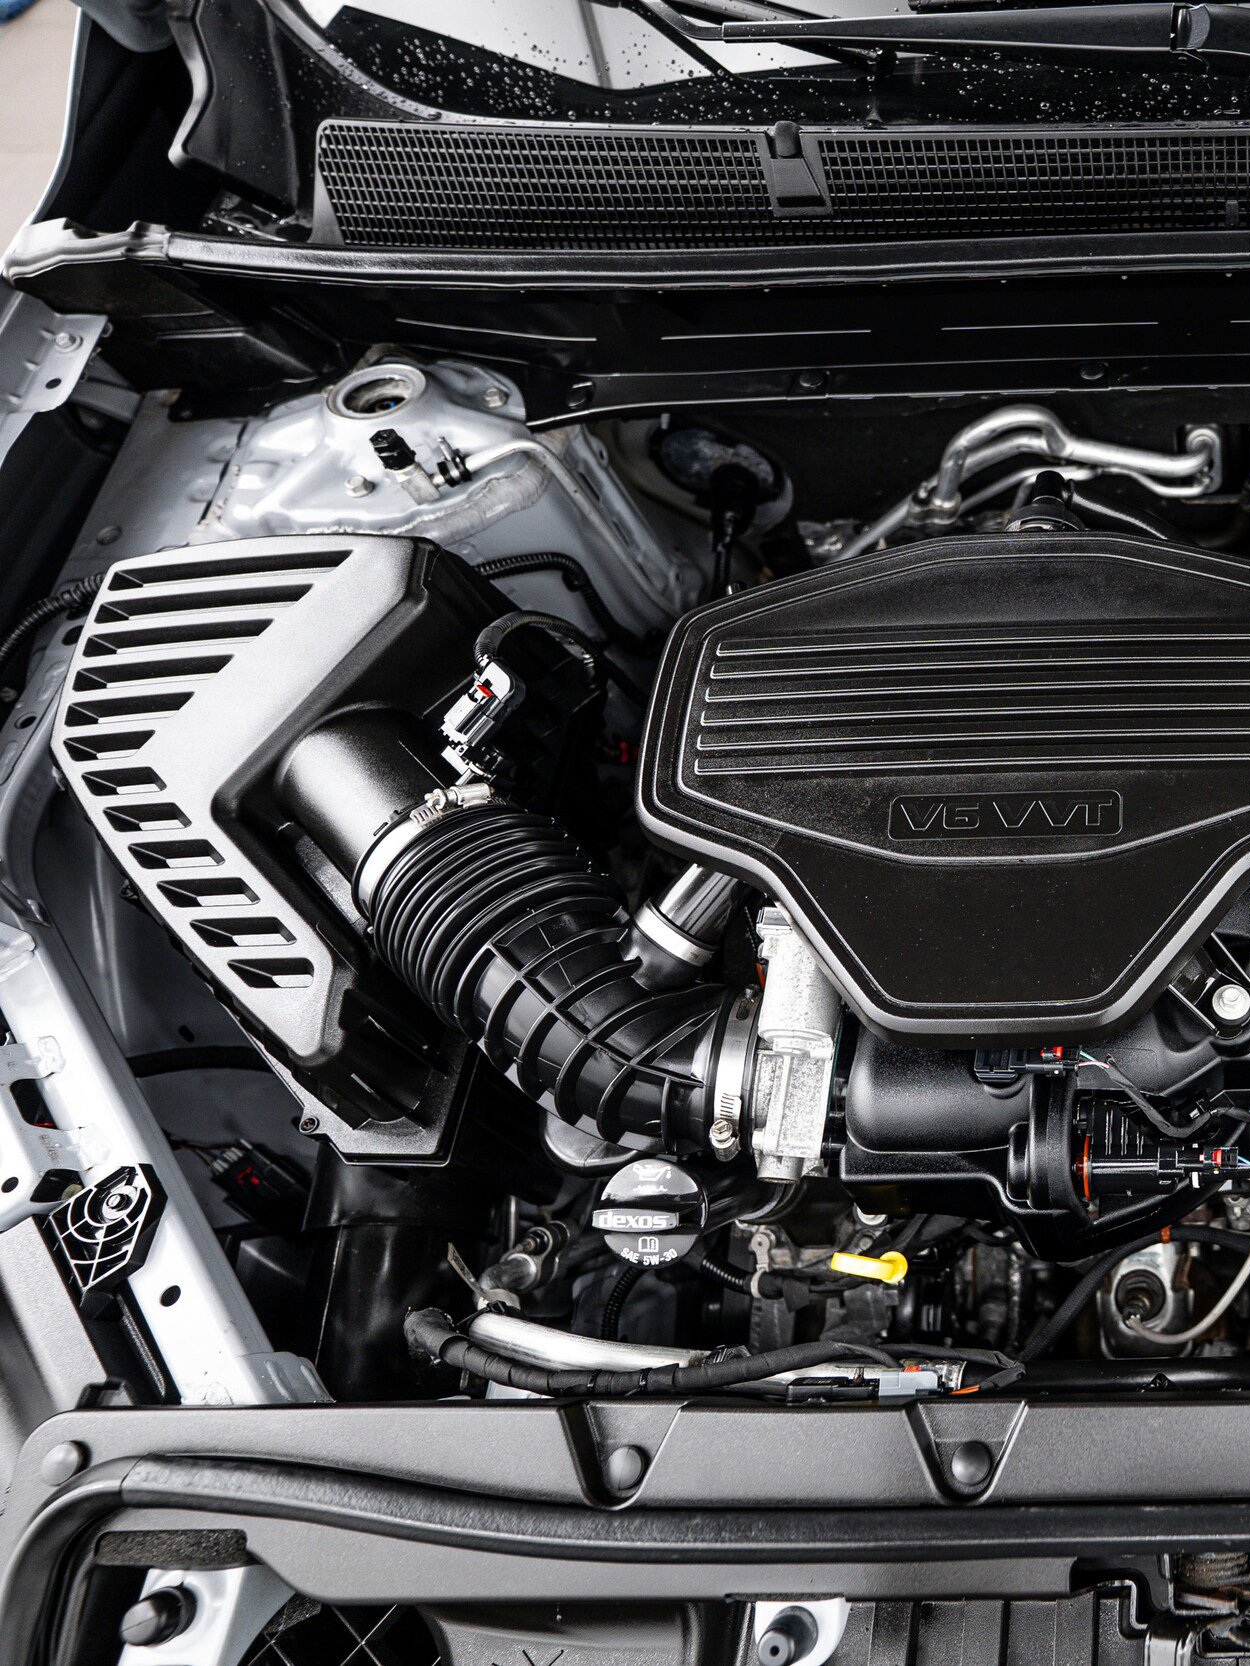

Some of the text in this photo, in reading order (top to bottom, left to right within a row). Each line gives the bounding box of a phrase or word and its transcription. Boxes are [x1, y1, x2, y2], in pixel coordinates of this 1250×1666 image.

[900, 799, 1113, 831] V6 VVT
[599, 1211, 670, 1229] dexos
[621, 1247, 678, 1266] SAE 5W-30
